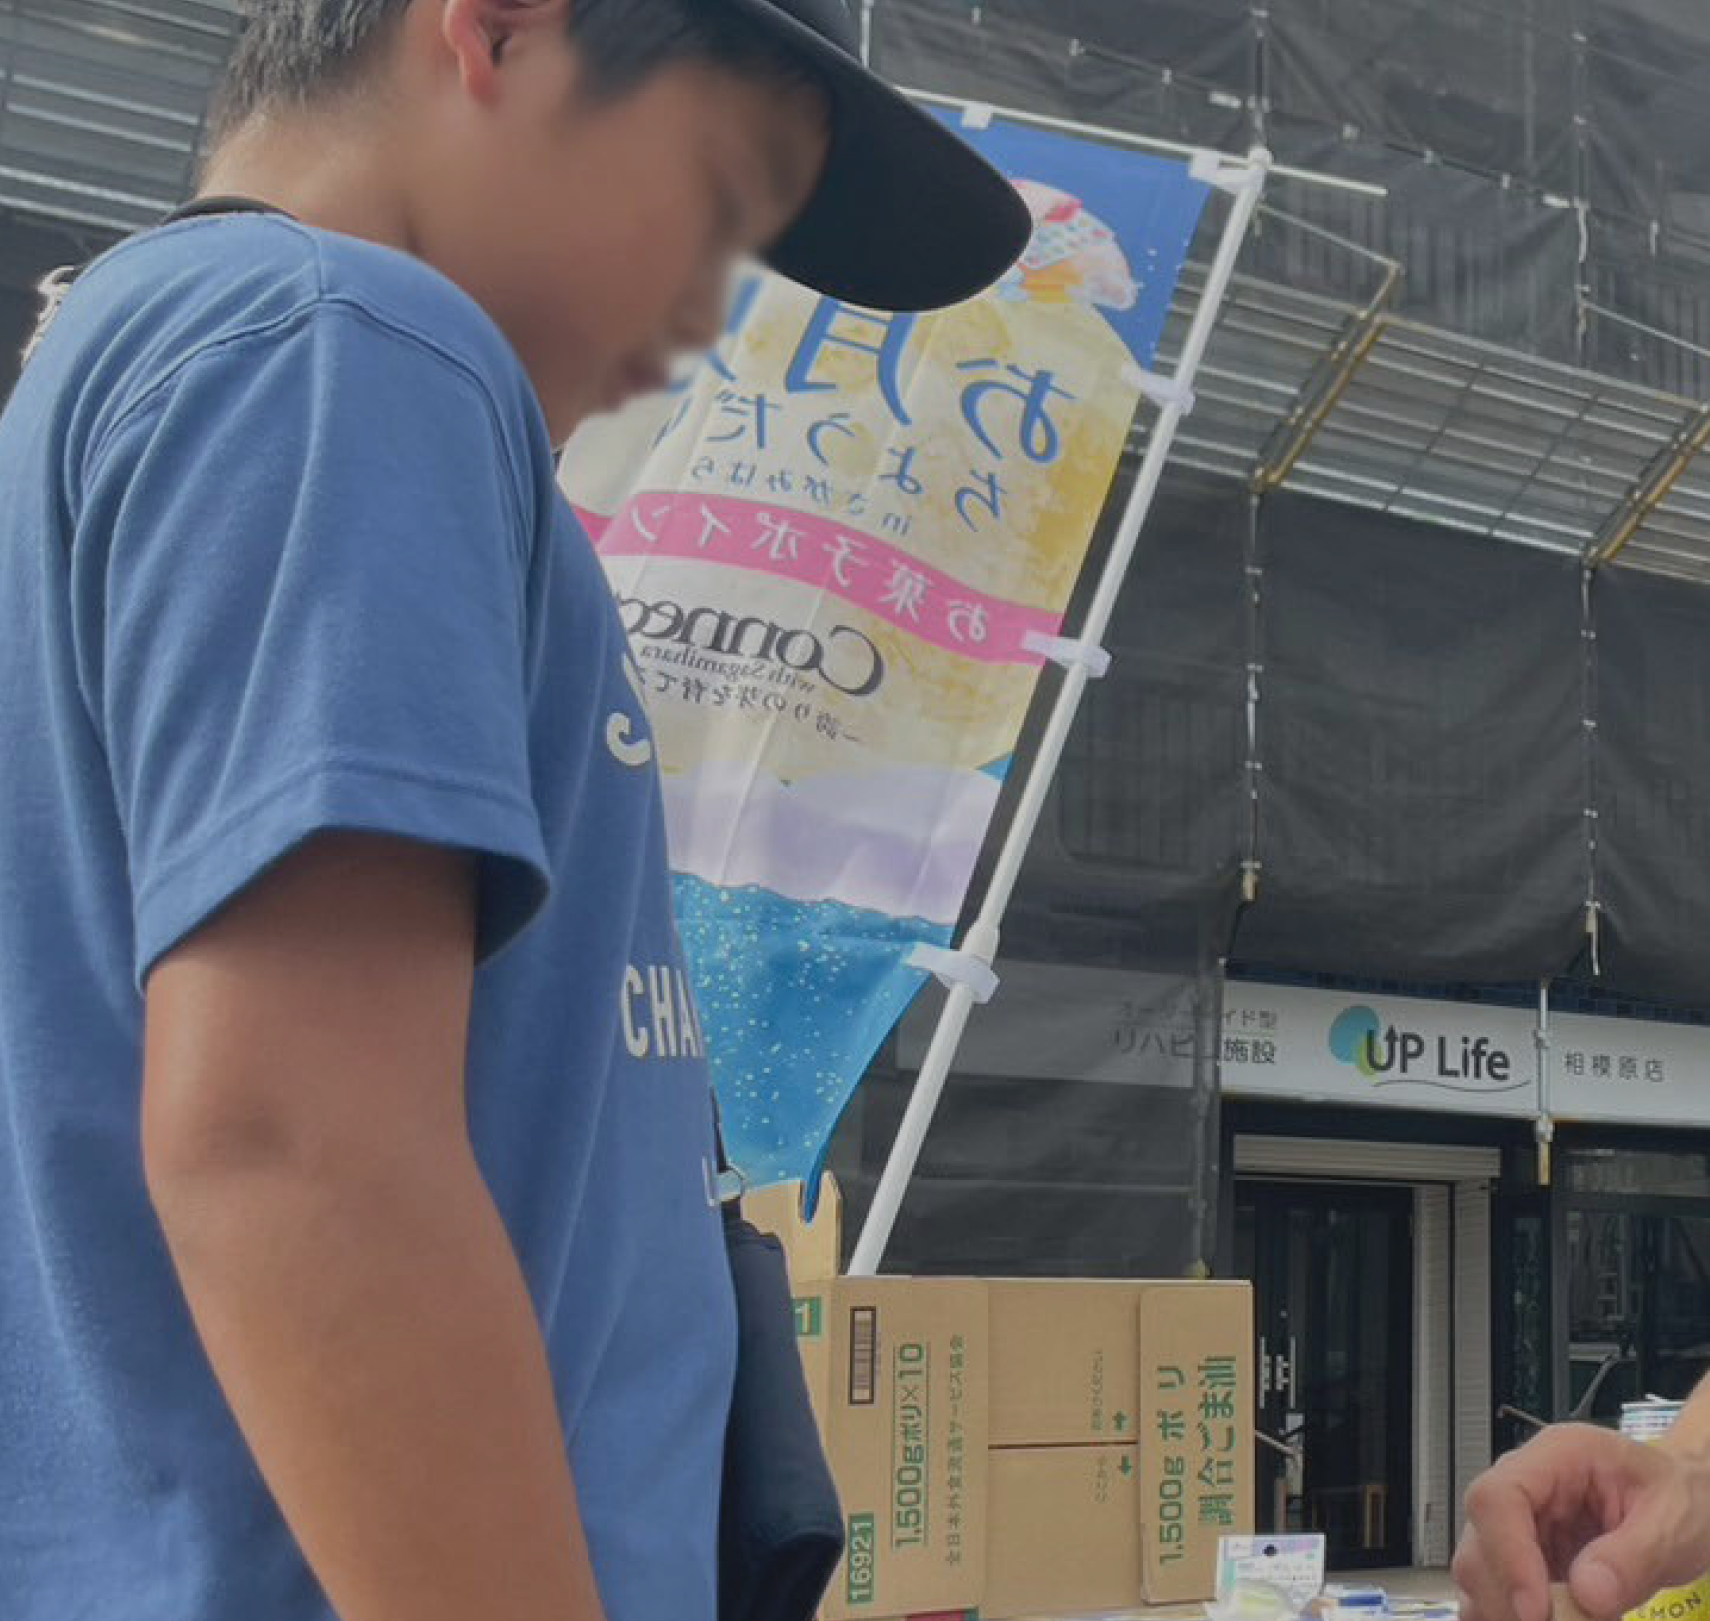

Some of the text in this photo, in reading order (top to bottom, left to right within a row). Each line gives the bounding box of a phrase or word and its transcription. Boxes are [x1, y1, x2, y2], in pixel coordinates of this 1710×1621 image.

[621, 963, 706, 1057] CHA
[1366, 1024, 1511, 1081] UP Life
[1564, 1050, 1664, 1082] 相模原店
[795, 1302, 812, 1334] 1
[1198, 1355, 1237, 1526] 調合ごま油
[851, 1521, 873, 1601] 16921
